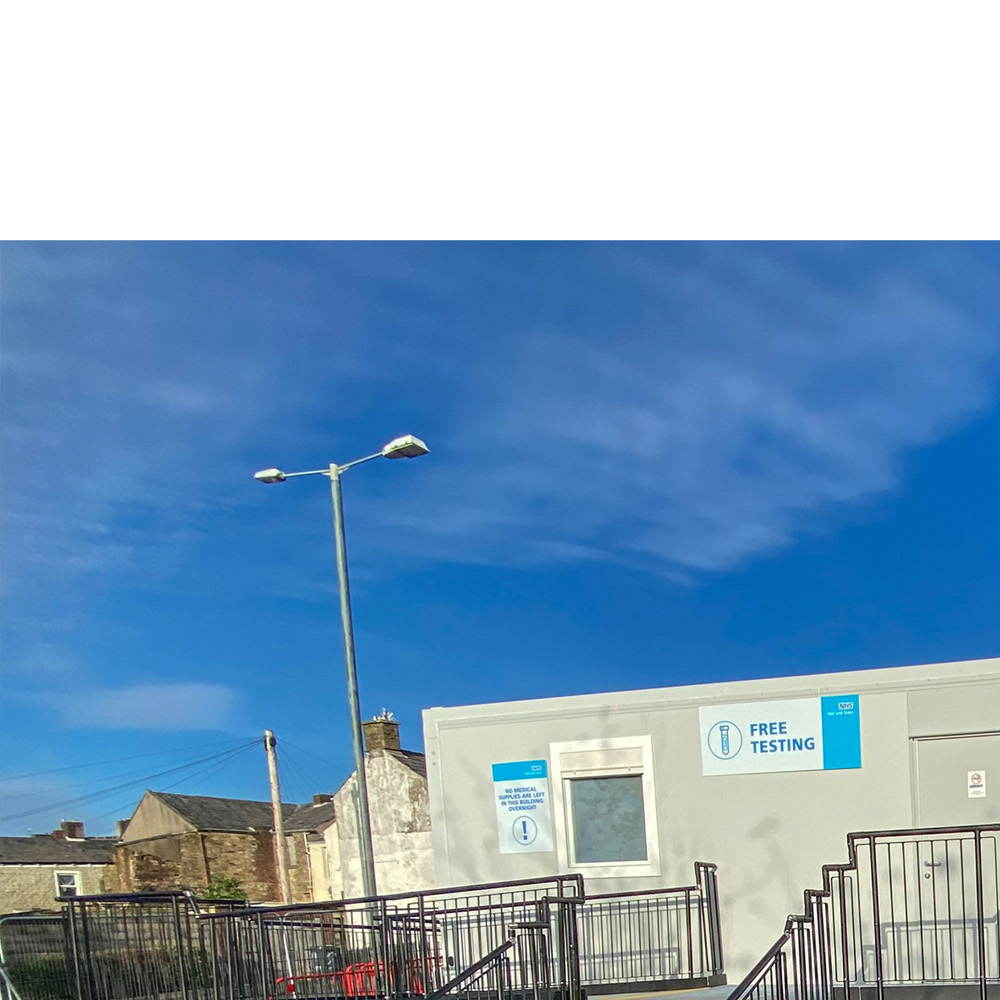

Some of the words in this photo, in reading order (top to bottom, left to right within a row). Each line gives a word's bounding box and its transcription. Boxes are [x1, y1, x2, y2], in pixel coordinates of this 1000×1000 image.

[839, 702, 853, 710] NHS
[750, 721, 787, 737] FREE
[750, 737, 815, 753] TESTING
